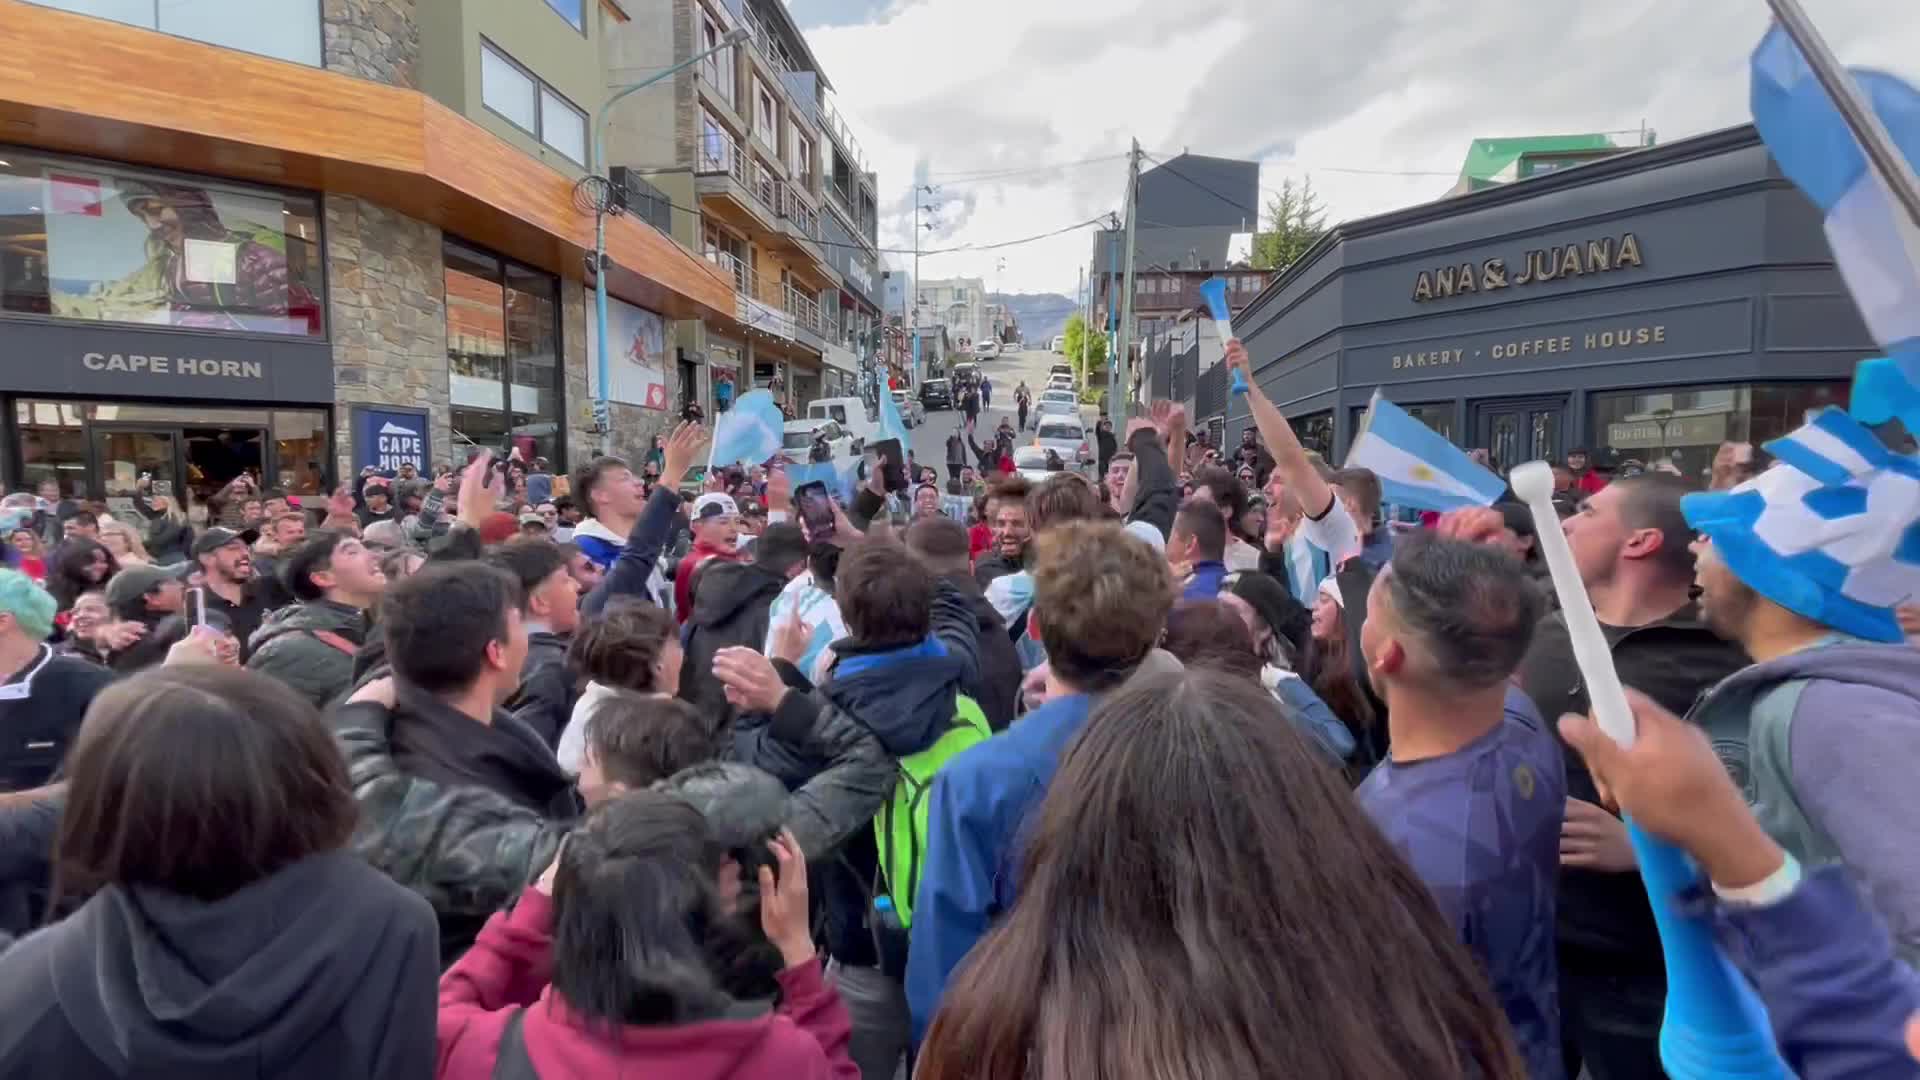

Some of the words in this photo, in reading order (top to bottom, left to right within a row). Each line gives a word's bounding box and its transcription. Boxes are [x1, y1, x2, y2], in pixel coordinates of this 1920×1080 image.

[1413, 264, 1477, 300] ANA
[1515, 233, 1642, 282] JUANA
[82, 352, 168, 373] CAPE
[176, 358, 262, 377] HORN
[1392, 349, 1464, 370] BAKERY
[1491, 336, 1572, 360] COFFEE
[1584, 326, 1666, 350] HOUSE
[379, 437, 421, 453] CAPE
